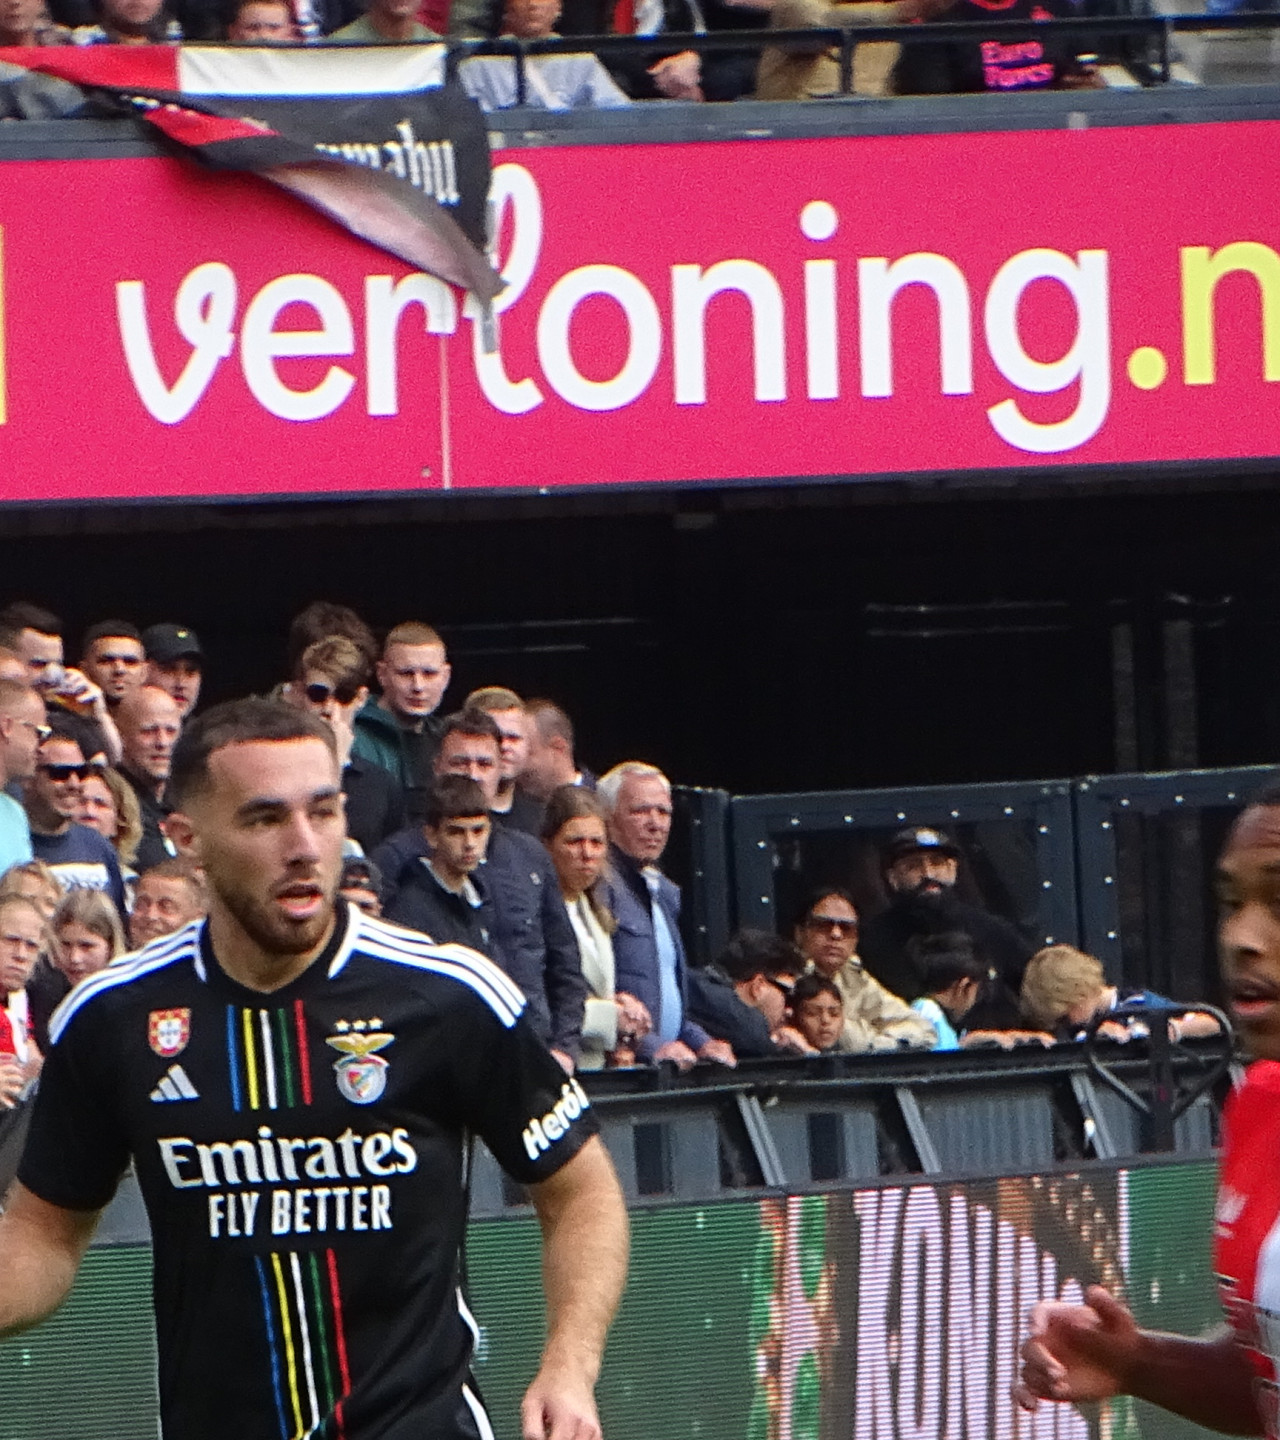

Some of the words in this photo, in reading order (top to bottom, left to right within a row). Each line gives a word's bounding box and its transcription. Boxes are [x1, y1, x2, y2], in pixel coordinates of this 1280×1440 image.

[157, 1125, 418, 1189] Emirates
[208, 1191, 260, 1238] FLY
[272, 1184, 393, 1235] BETTER
